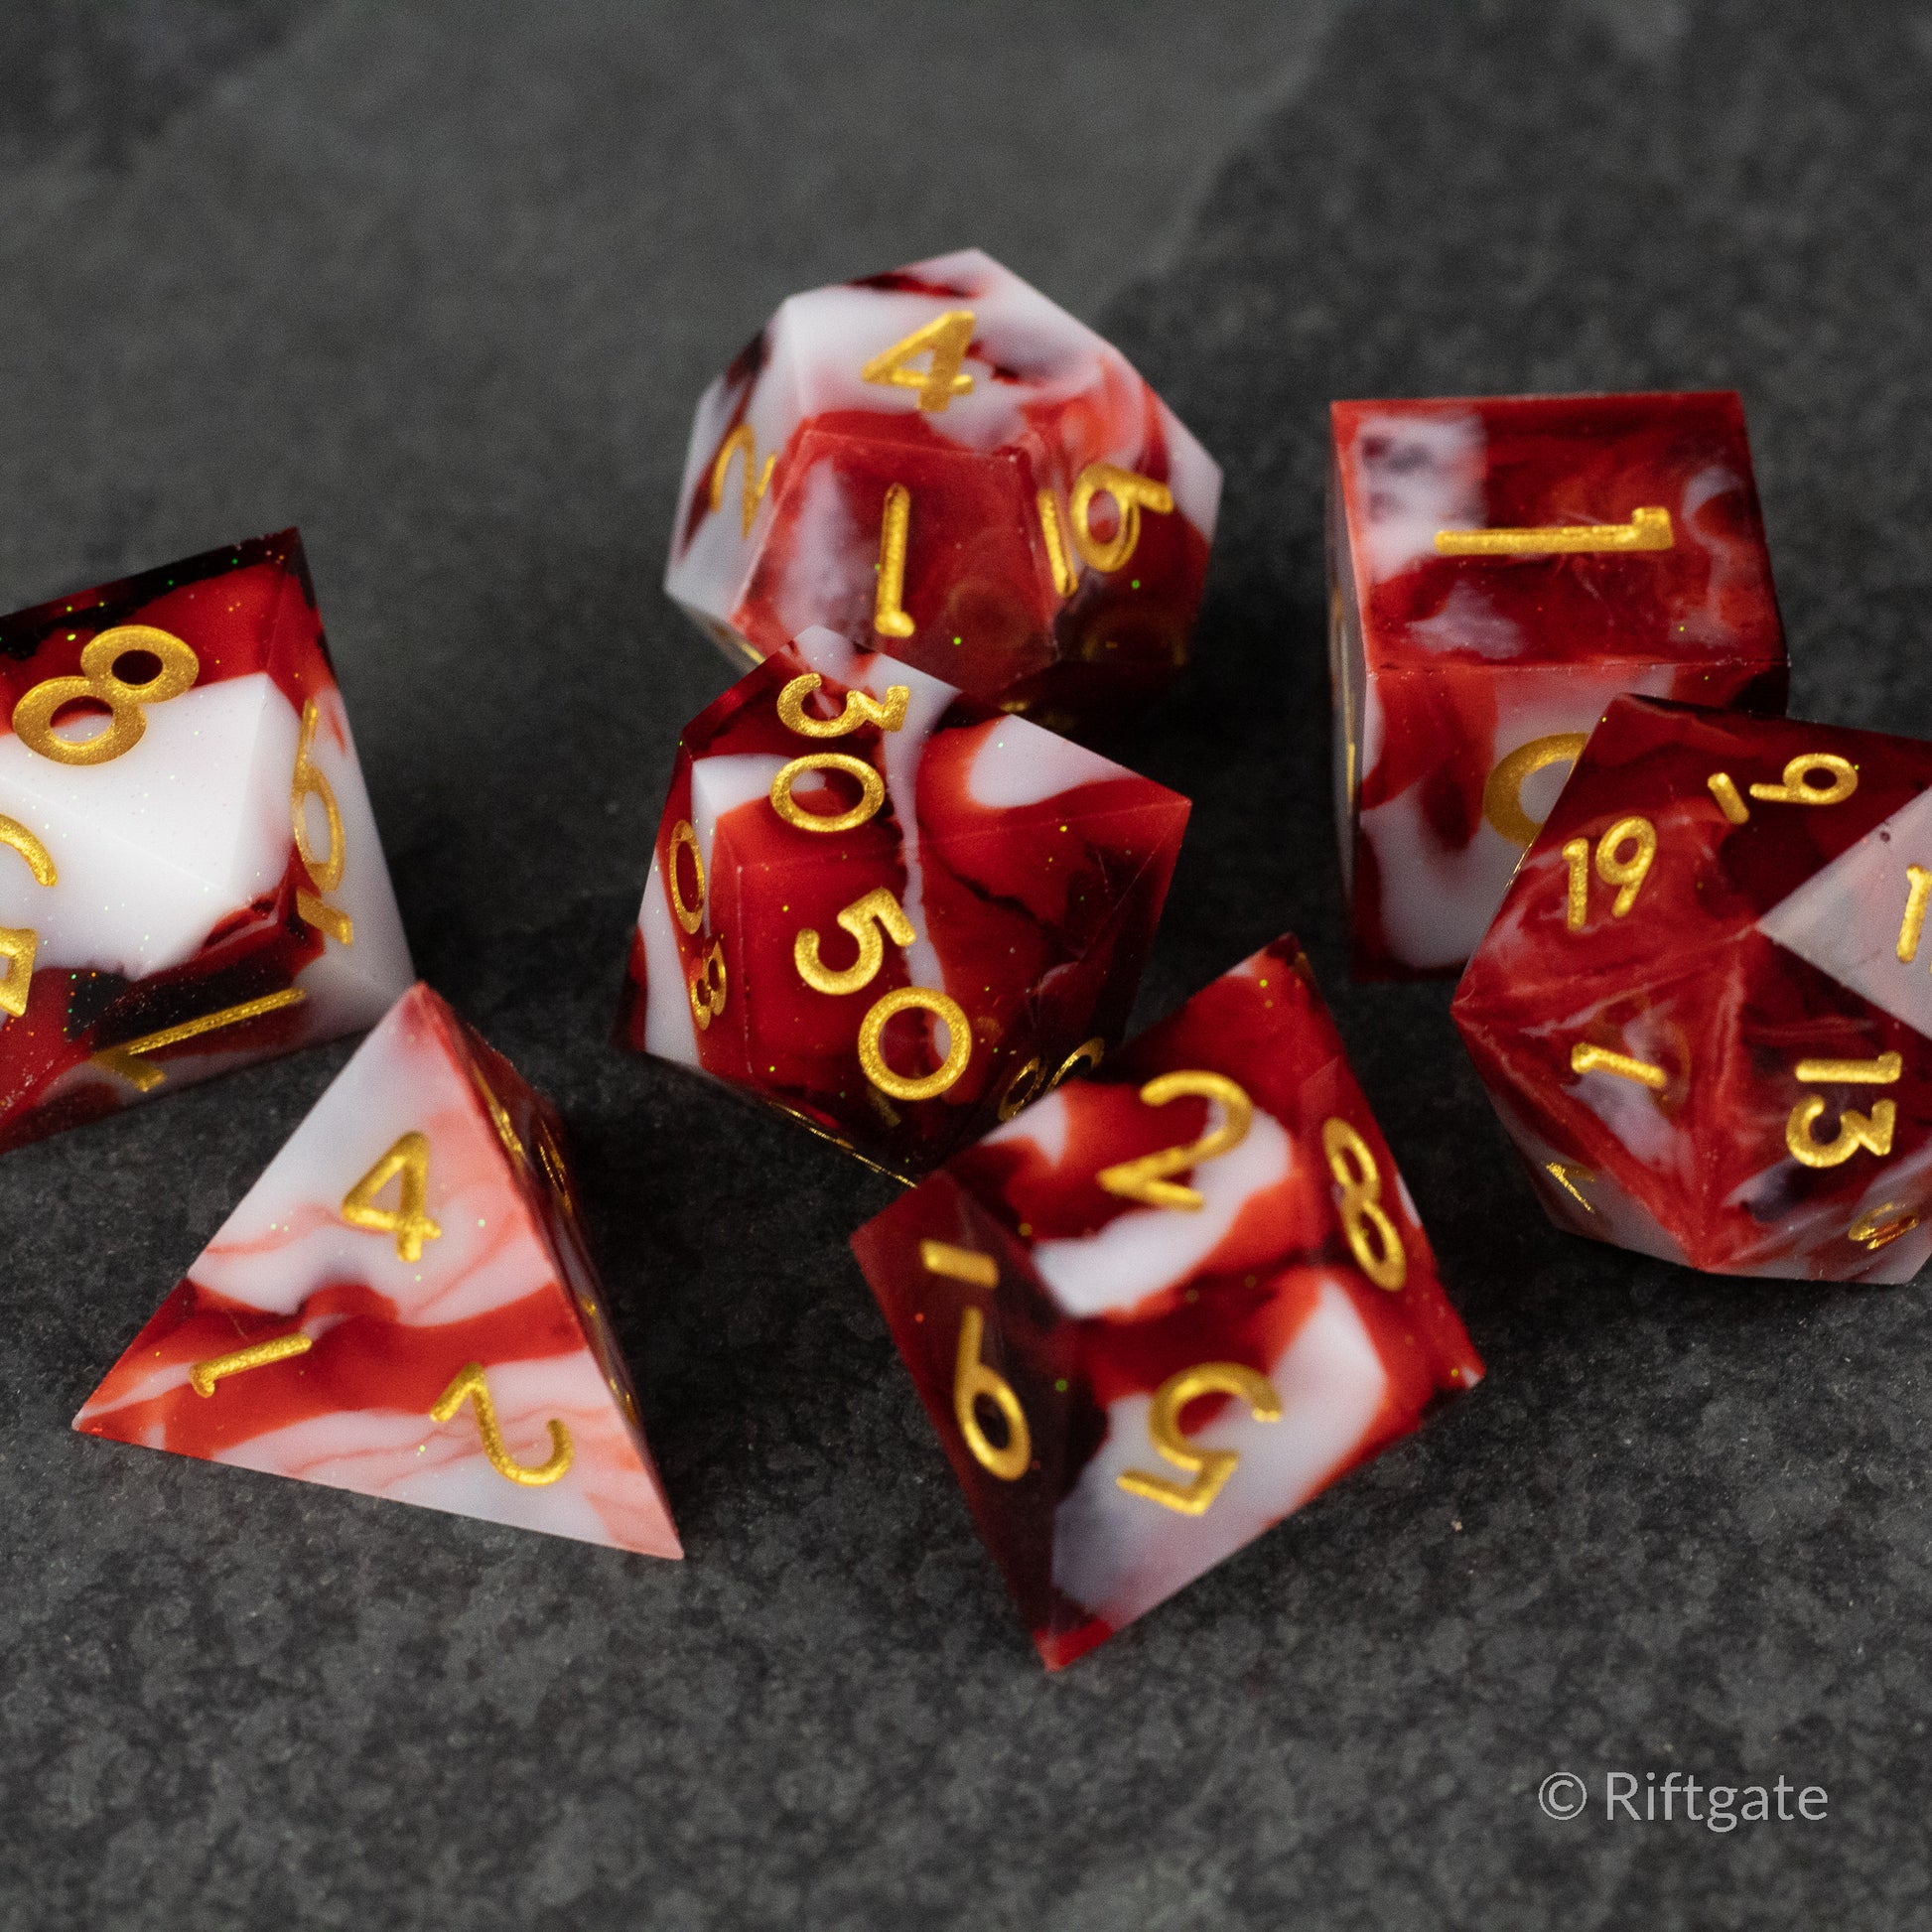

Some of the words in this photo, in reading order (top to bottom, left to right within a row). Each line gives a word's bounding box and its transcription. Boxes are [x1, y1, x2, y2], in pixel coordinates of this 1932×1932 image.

[862, 311, 976, 413] 4
[875, 483, 915, 638] 1
[1435, 506, 1674, 556] 1
[11, 623, 200, 765] 8
[1562, 816, 1657, 932] 19
[794, 887, 973, 1101] 50
[1571, 1042, 1667, 1088] 1
[1785, 1050, 1902, 1168] 13
[342, 1130, 443, 1264] 4
[1097, 1069, 1253, 1212] 2
[1322, 1116, 1407, 1291] 8
[190, 1332, 312, 1399] 1
[430, 1363, 575, 1487] 2
[1116, 1361, 1283, 1516] 5
